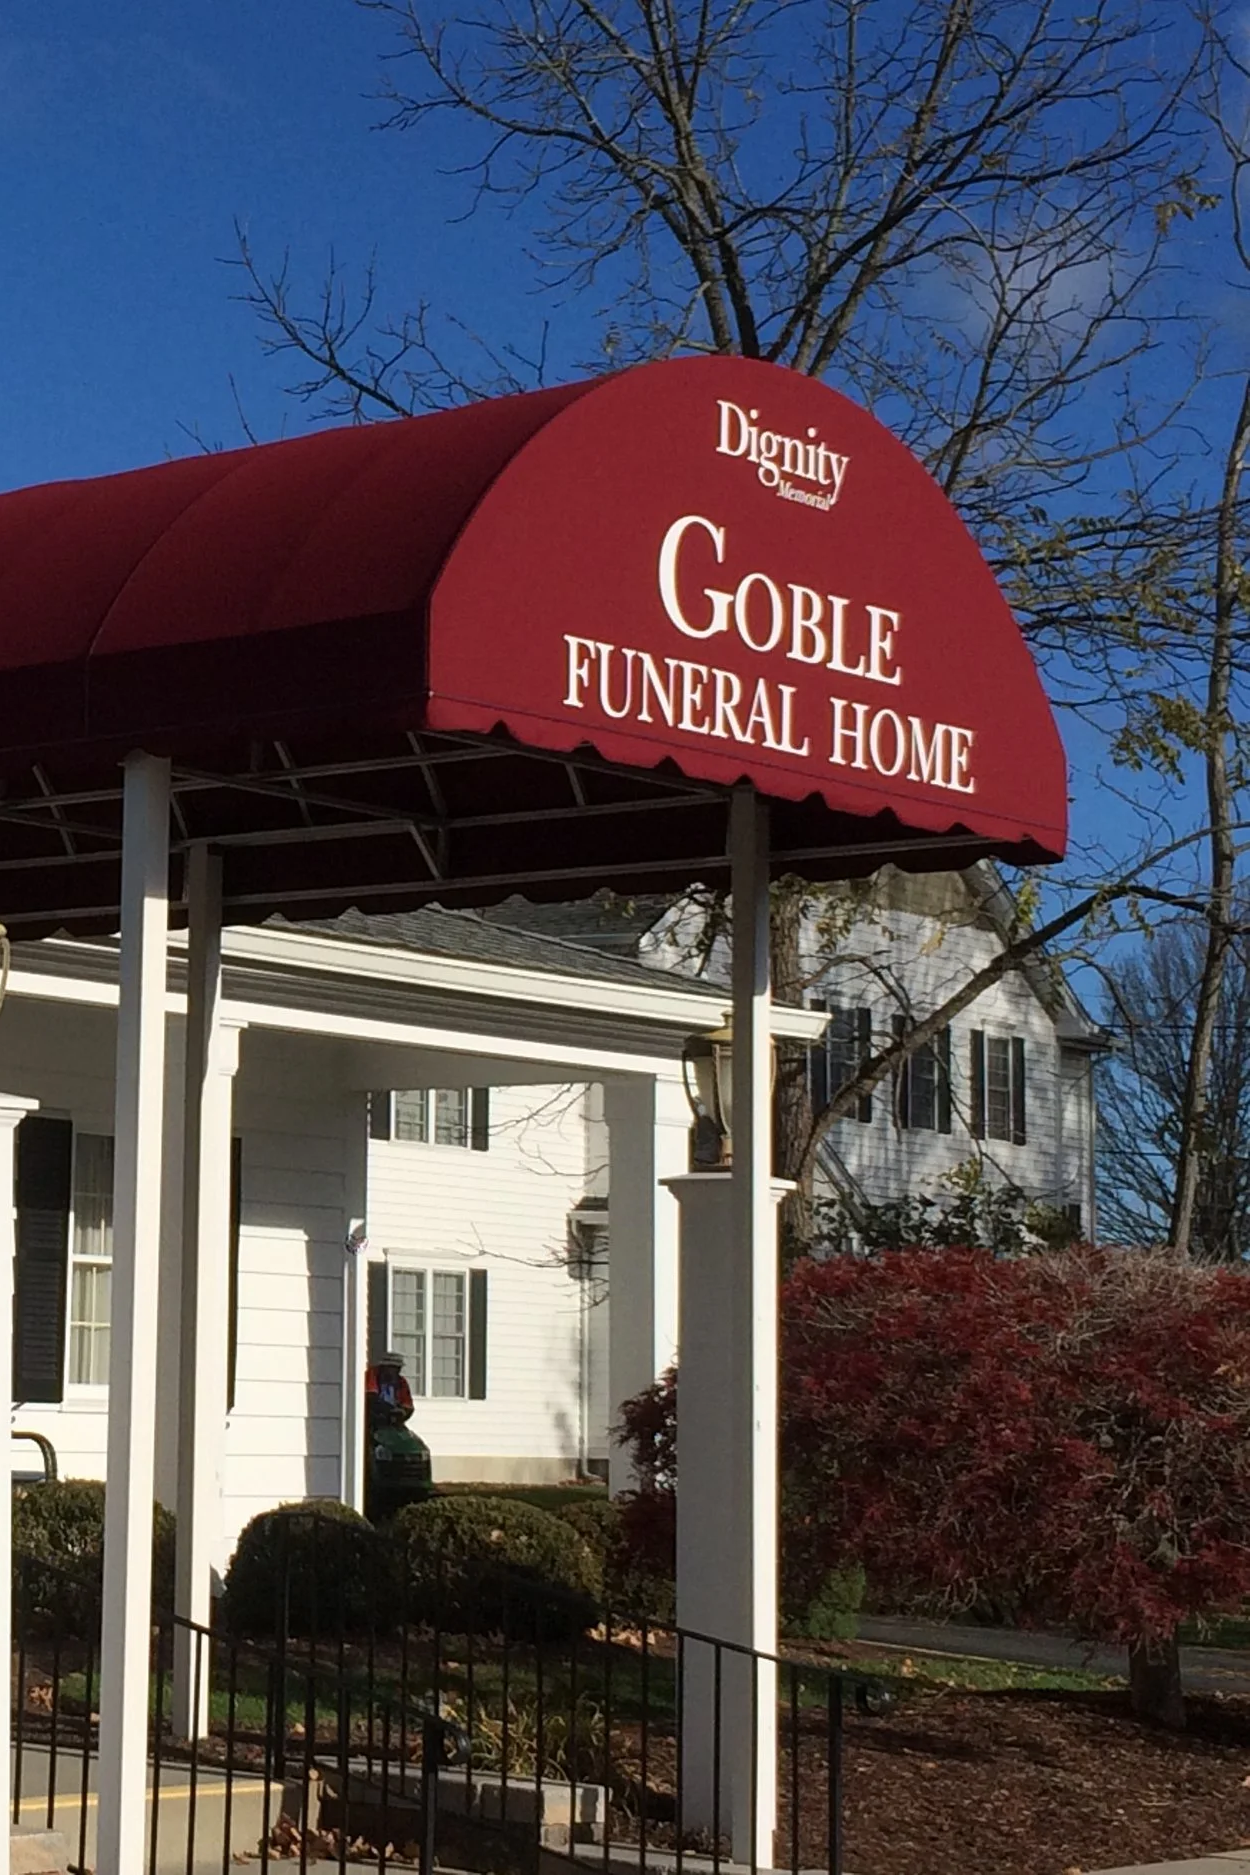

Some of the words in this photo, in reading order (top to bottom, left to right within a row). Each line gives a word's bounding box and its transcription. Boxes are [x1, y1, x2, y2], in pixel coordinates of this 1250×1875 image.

[716, 399, 850, 505] Dignity
[776, 479, 832, 511] Memorial
[658, 515, 902, 686] GOBLE
[562, 633, 810, 757] FUNERAL
[828, 697, 976, 794] HOME
